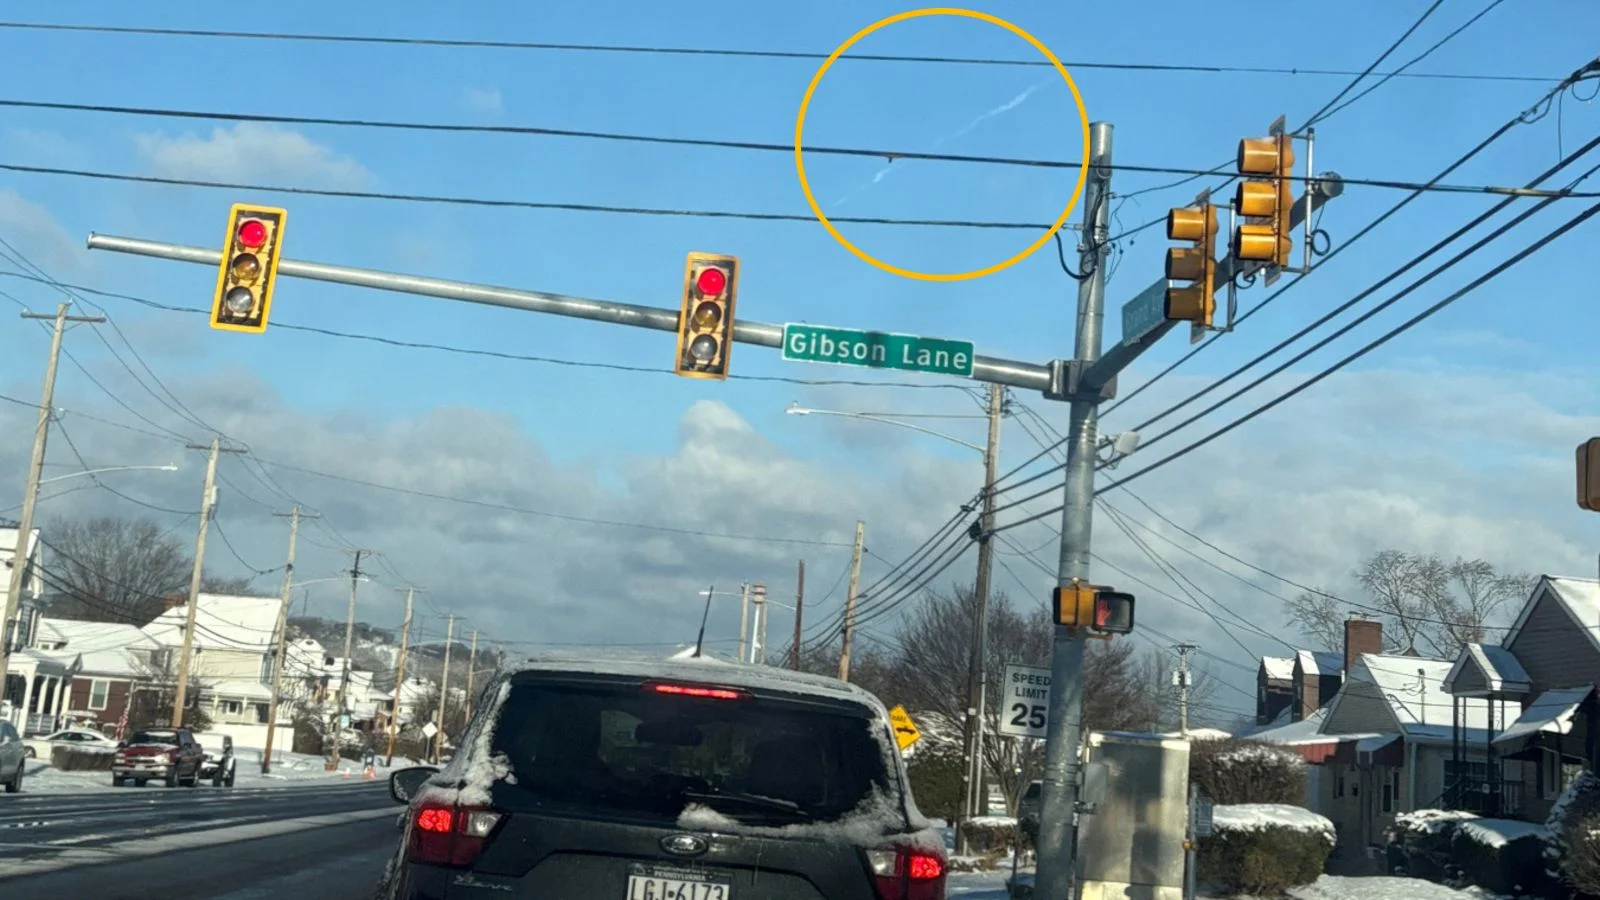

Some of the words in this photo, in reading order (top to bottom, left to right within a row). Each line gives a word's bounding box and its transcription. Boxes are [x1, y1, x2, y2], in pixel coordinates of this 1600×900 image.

[790, 332, 885, 362] Gibson
[902, 343, 967, 370] Lane
[1012, 672, 1052, 686] SPEED
[1015, 686, 1048, 699] LIMIT
[1010, 702, 1047, 729] 25
